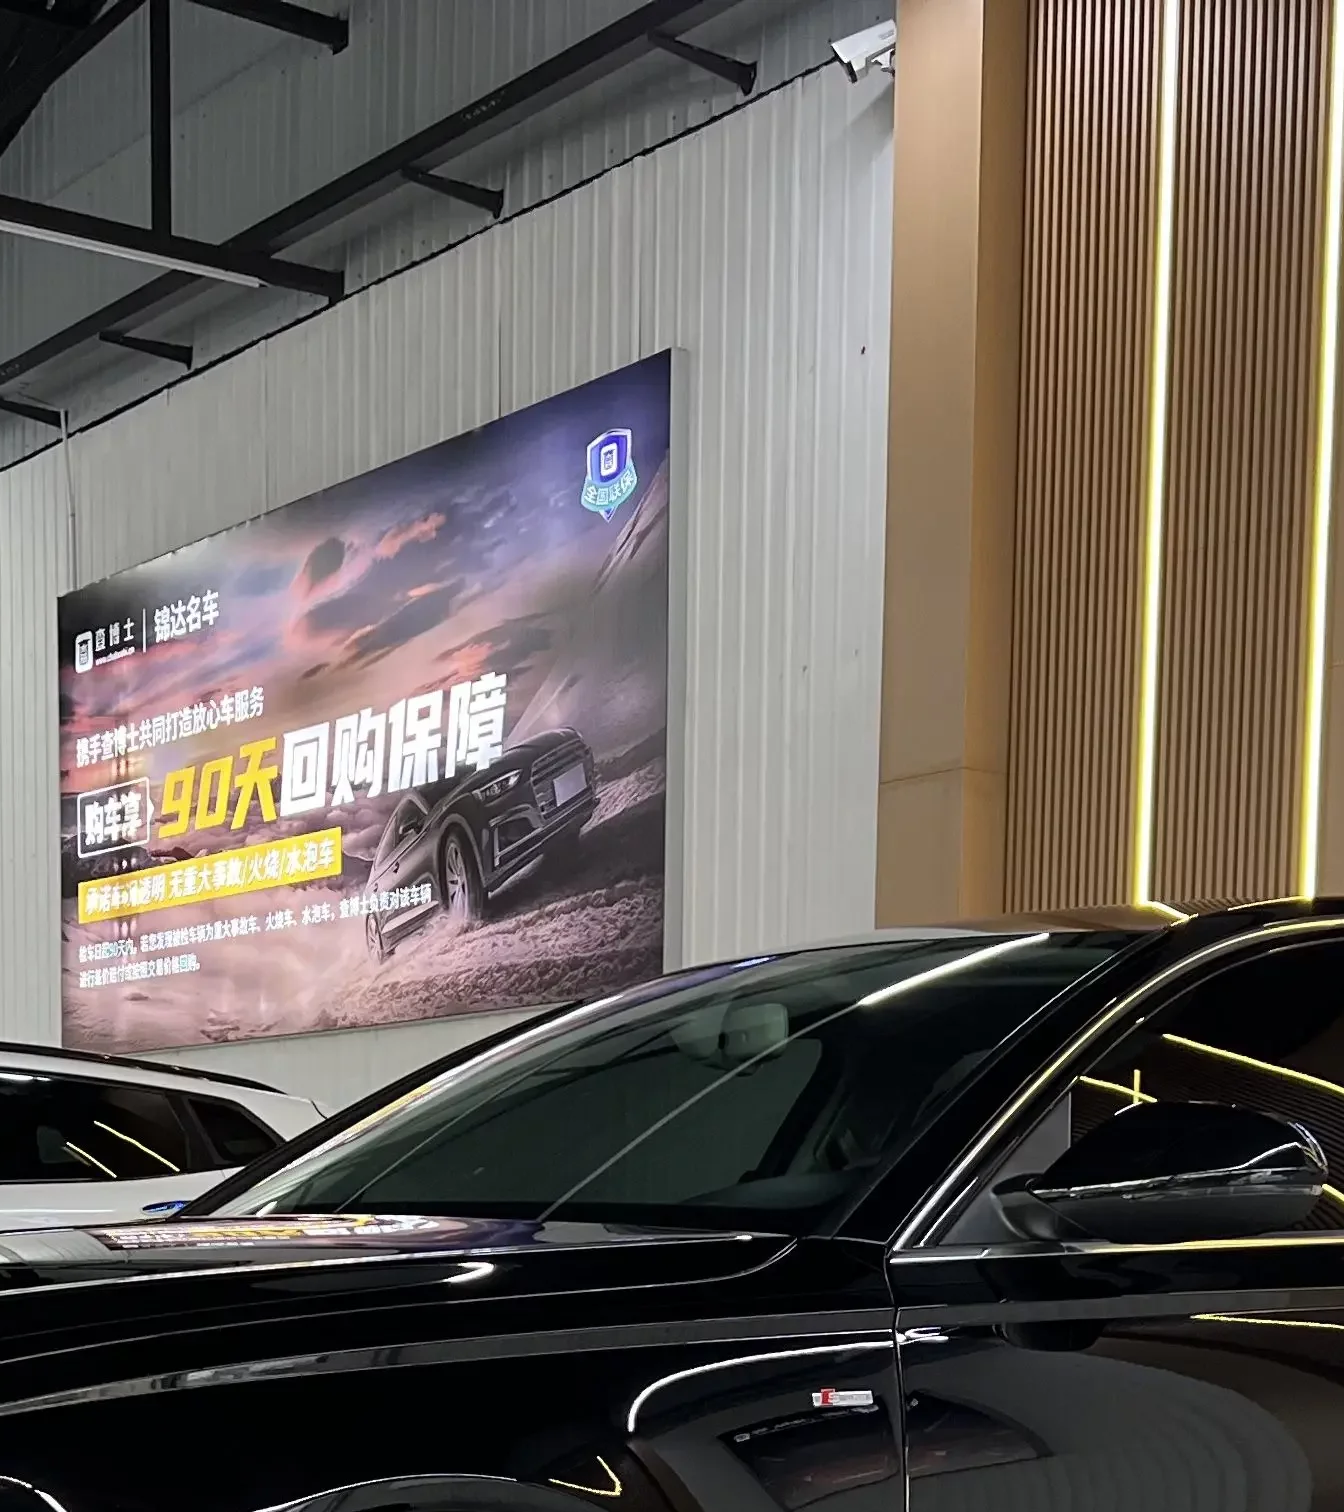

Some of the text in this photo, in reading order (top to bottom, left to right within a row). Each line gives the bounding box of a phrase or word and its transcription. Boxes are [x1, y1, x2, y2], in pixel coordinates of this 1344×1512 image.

[154, 590, 220, 643] 锦达名车
[76, 686, 265, 768] 携手查博士共同打造放心车服务
[158, 671, 507, 839] 90天回购保障
